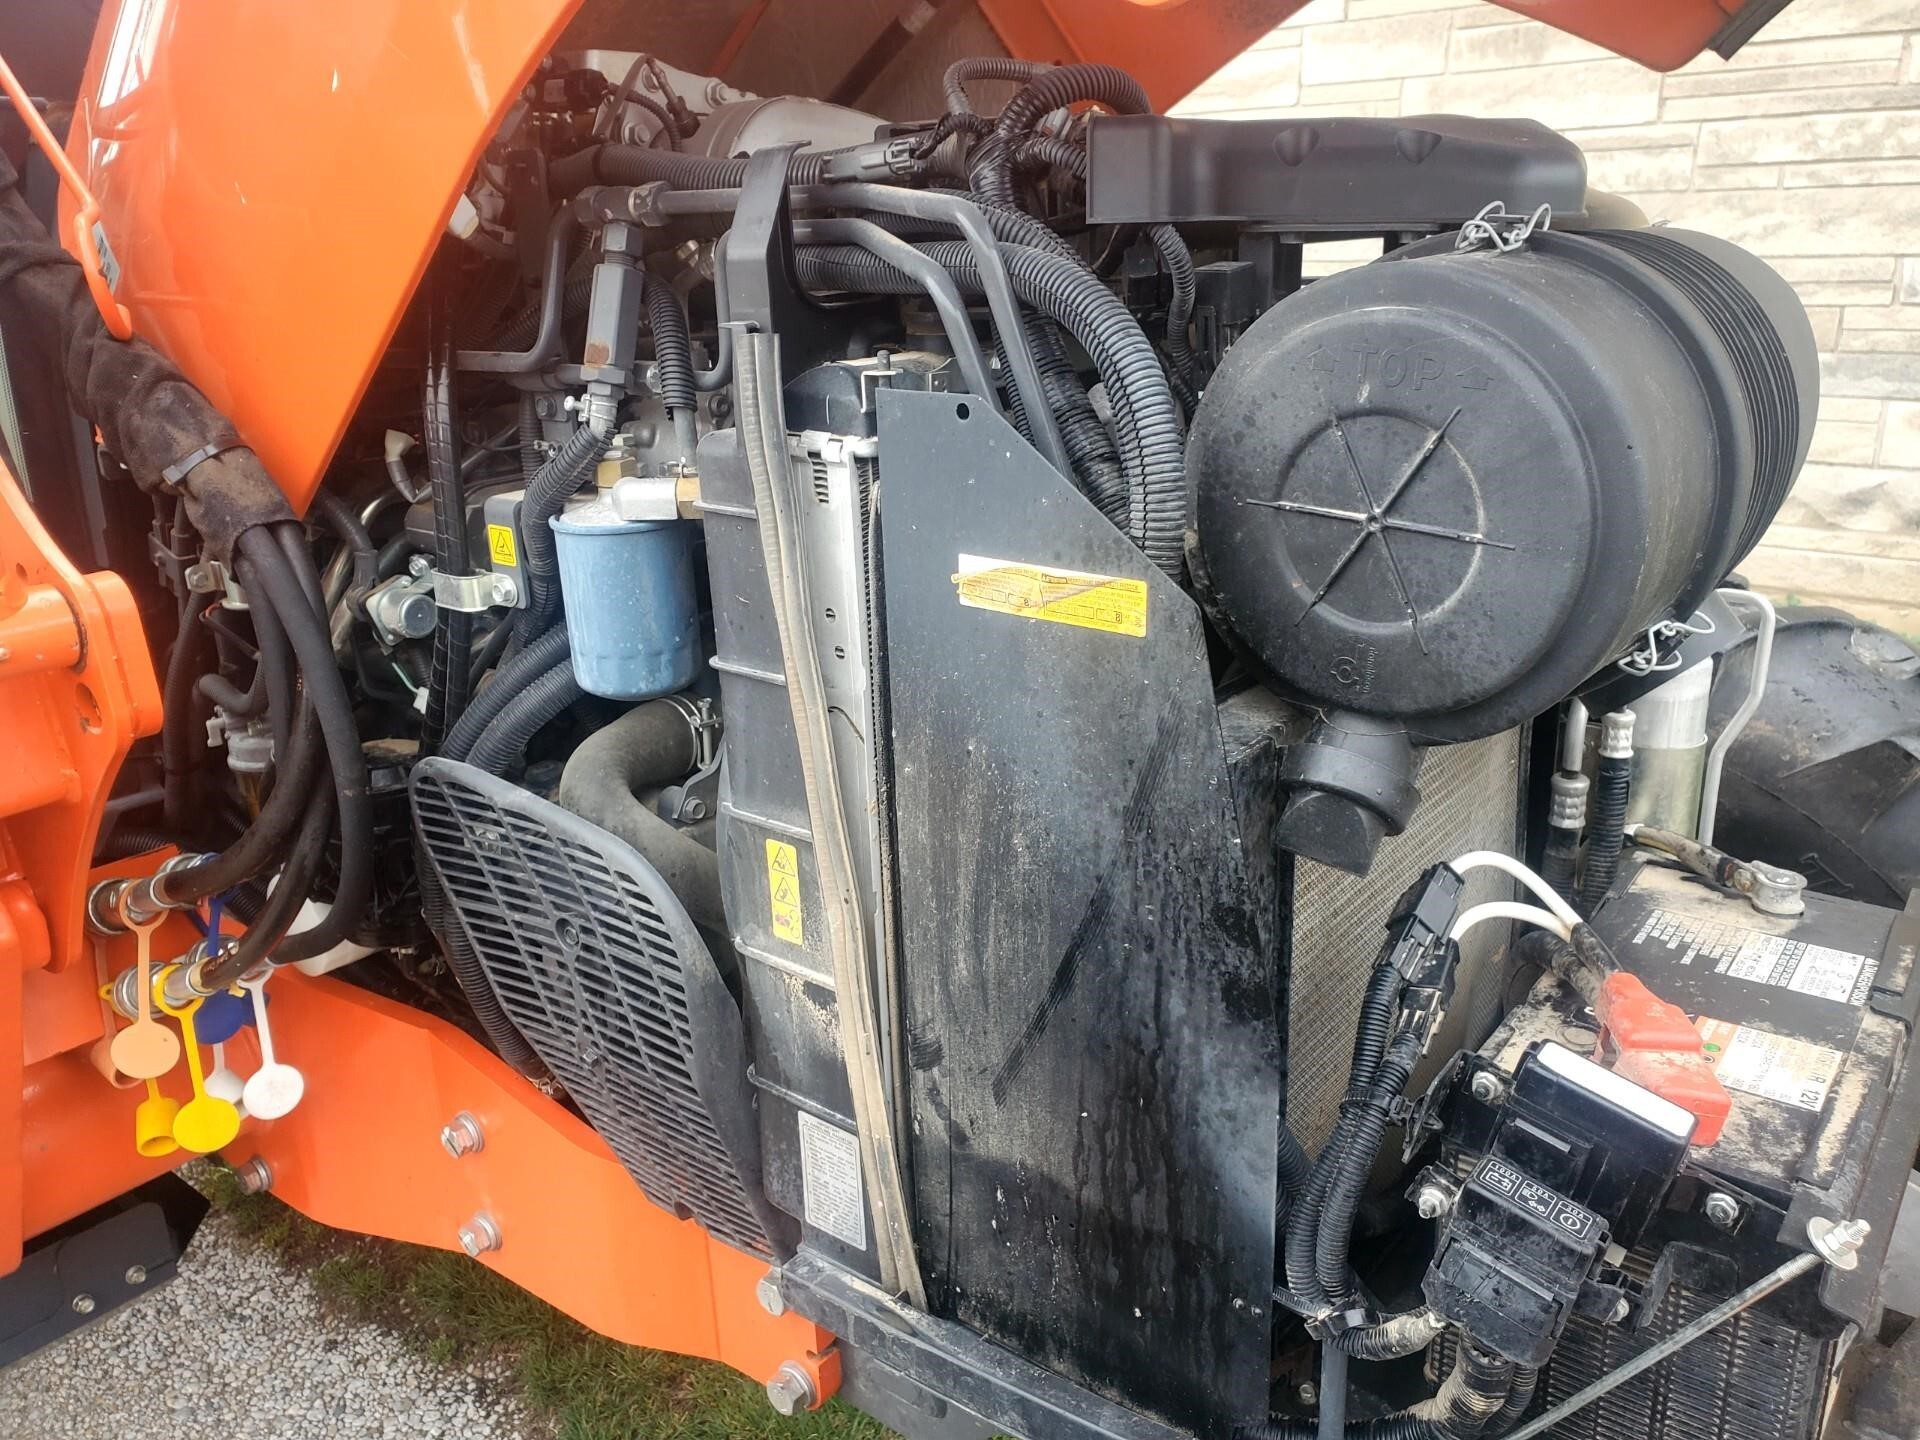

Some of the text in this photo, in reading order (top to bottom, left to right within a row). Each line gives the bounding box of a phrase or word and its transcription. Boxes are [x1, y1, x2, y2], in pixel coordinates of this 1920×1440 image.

[1352, 343, 1446, 391] TOP
[1799, 1088, 1822, 1109] 12V
[1495, 1163, 1517, 1181] 100A
